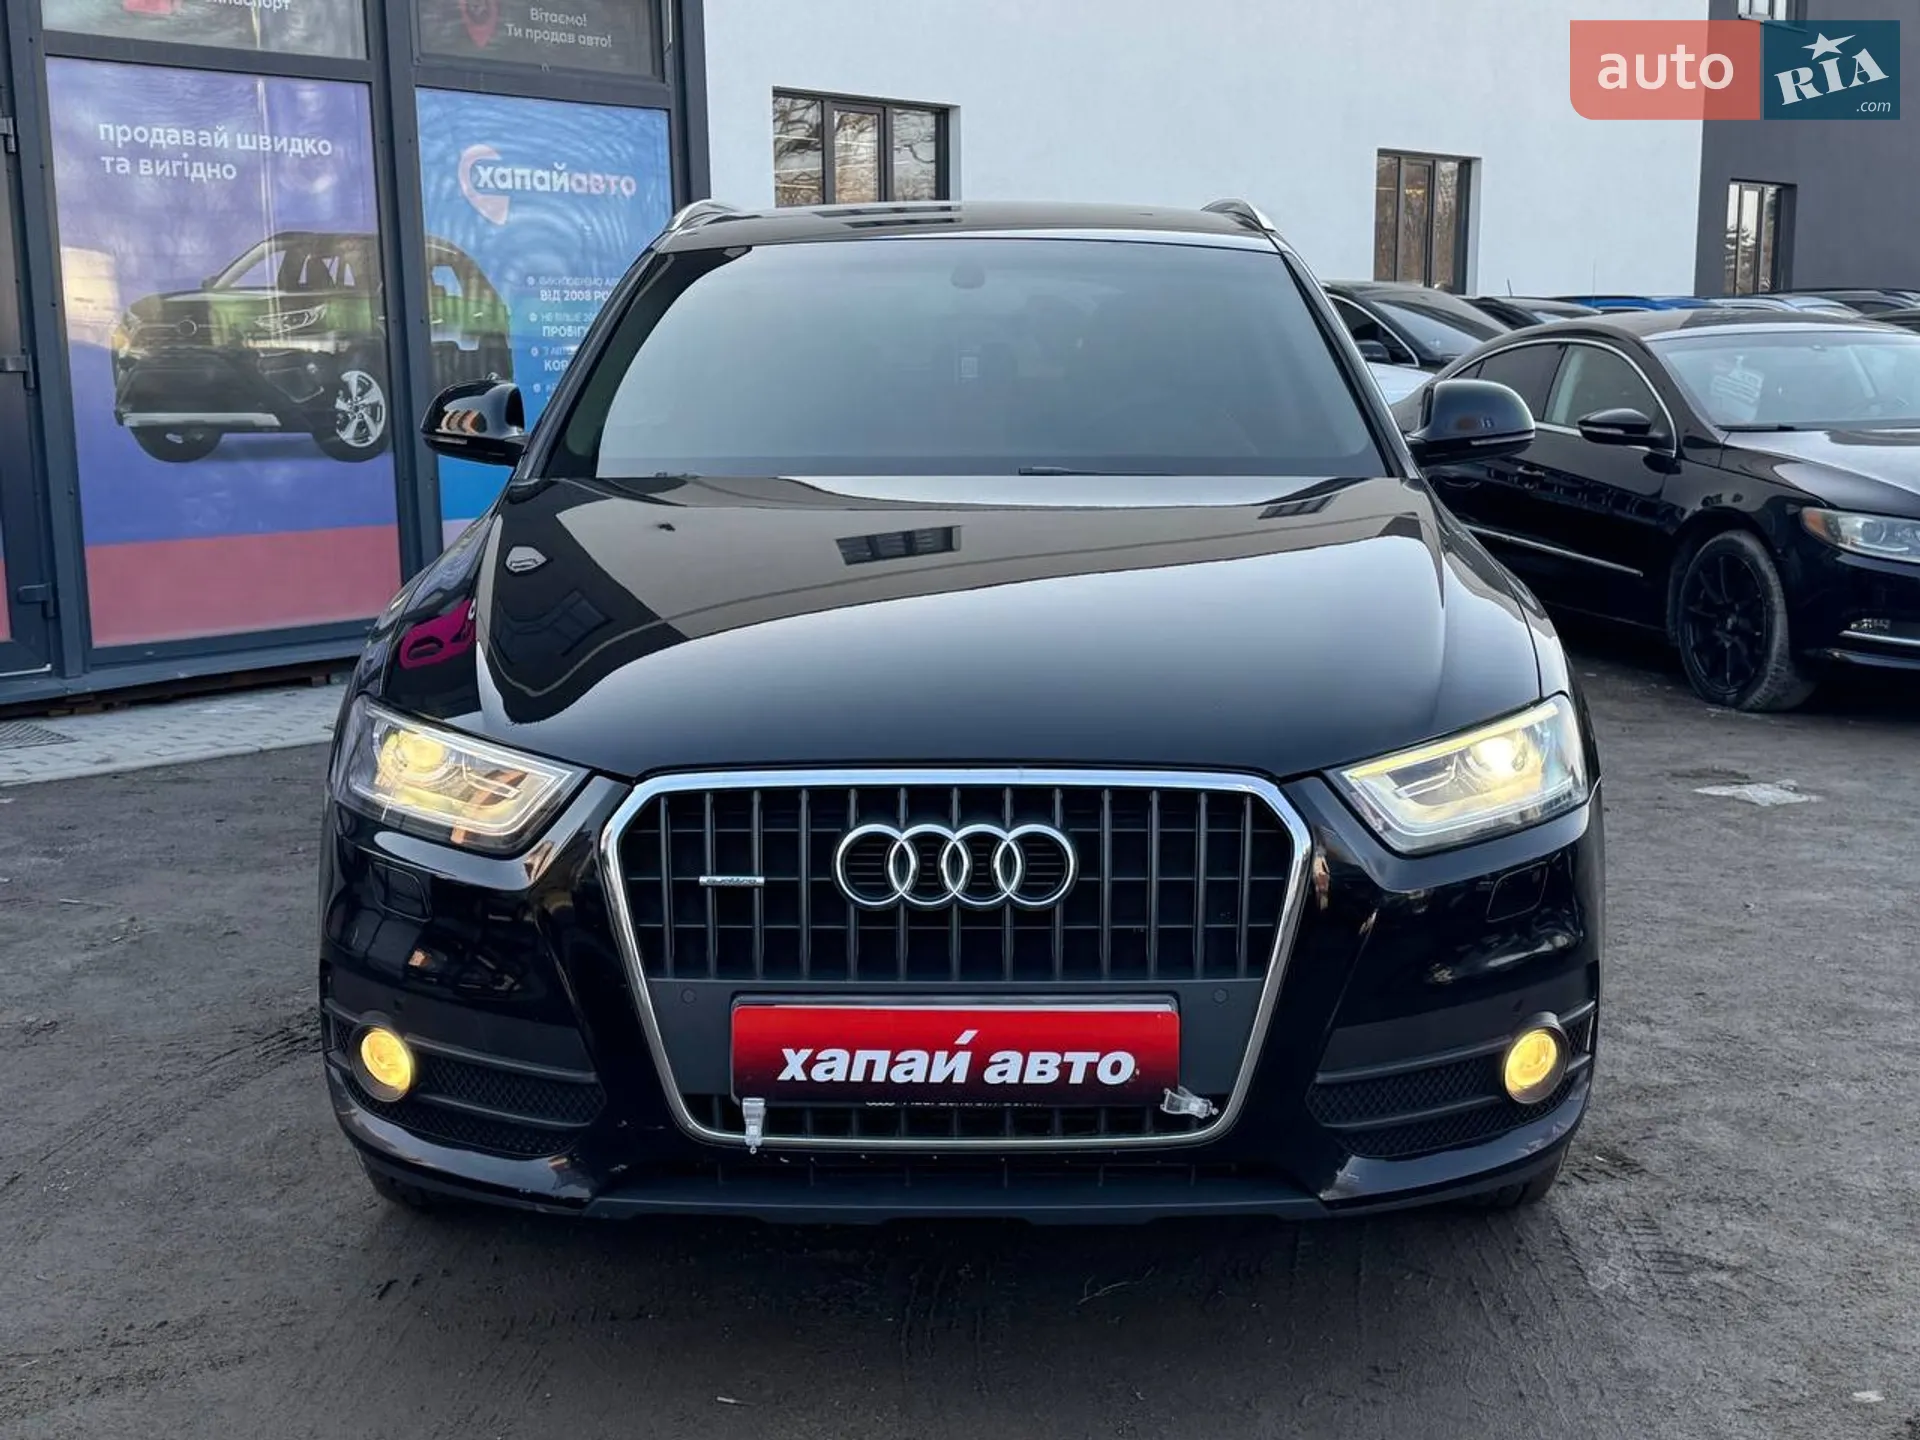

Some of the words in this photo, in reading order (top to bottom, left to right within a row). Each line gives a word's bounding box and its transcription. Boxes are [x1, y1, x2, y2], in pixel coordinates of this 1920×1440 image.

[530, 7, 587, 27] Вітаємо!
[505, 23, 523, 37] Ти
[525, 28, 575, 43] продав
[578, 34, 613, 48] авто!
[99, 122, 229, 149] продавай
[236, 131, 333, 158] швидко
[101, 155, 131, 175] та
[139, 152, 238, 183] вигідно
[476, 162, 637, 198] хапайавто
[540, 289, 561, 302] ВІД
[563, 290, 592, 301] 2008
[594, 290, 610, 301] РО
[542, 326, 586, 337] ПРОБІГ
[544, 360, 569, 371] КОР
[983, 1051, 1136, 1085] авто
